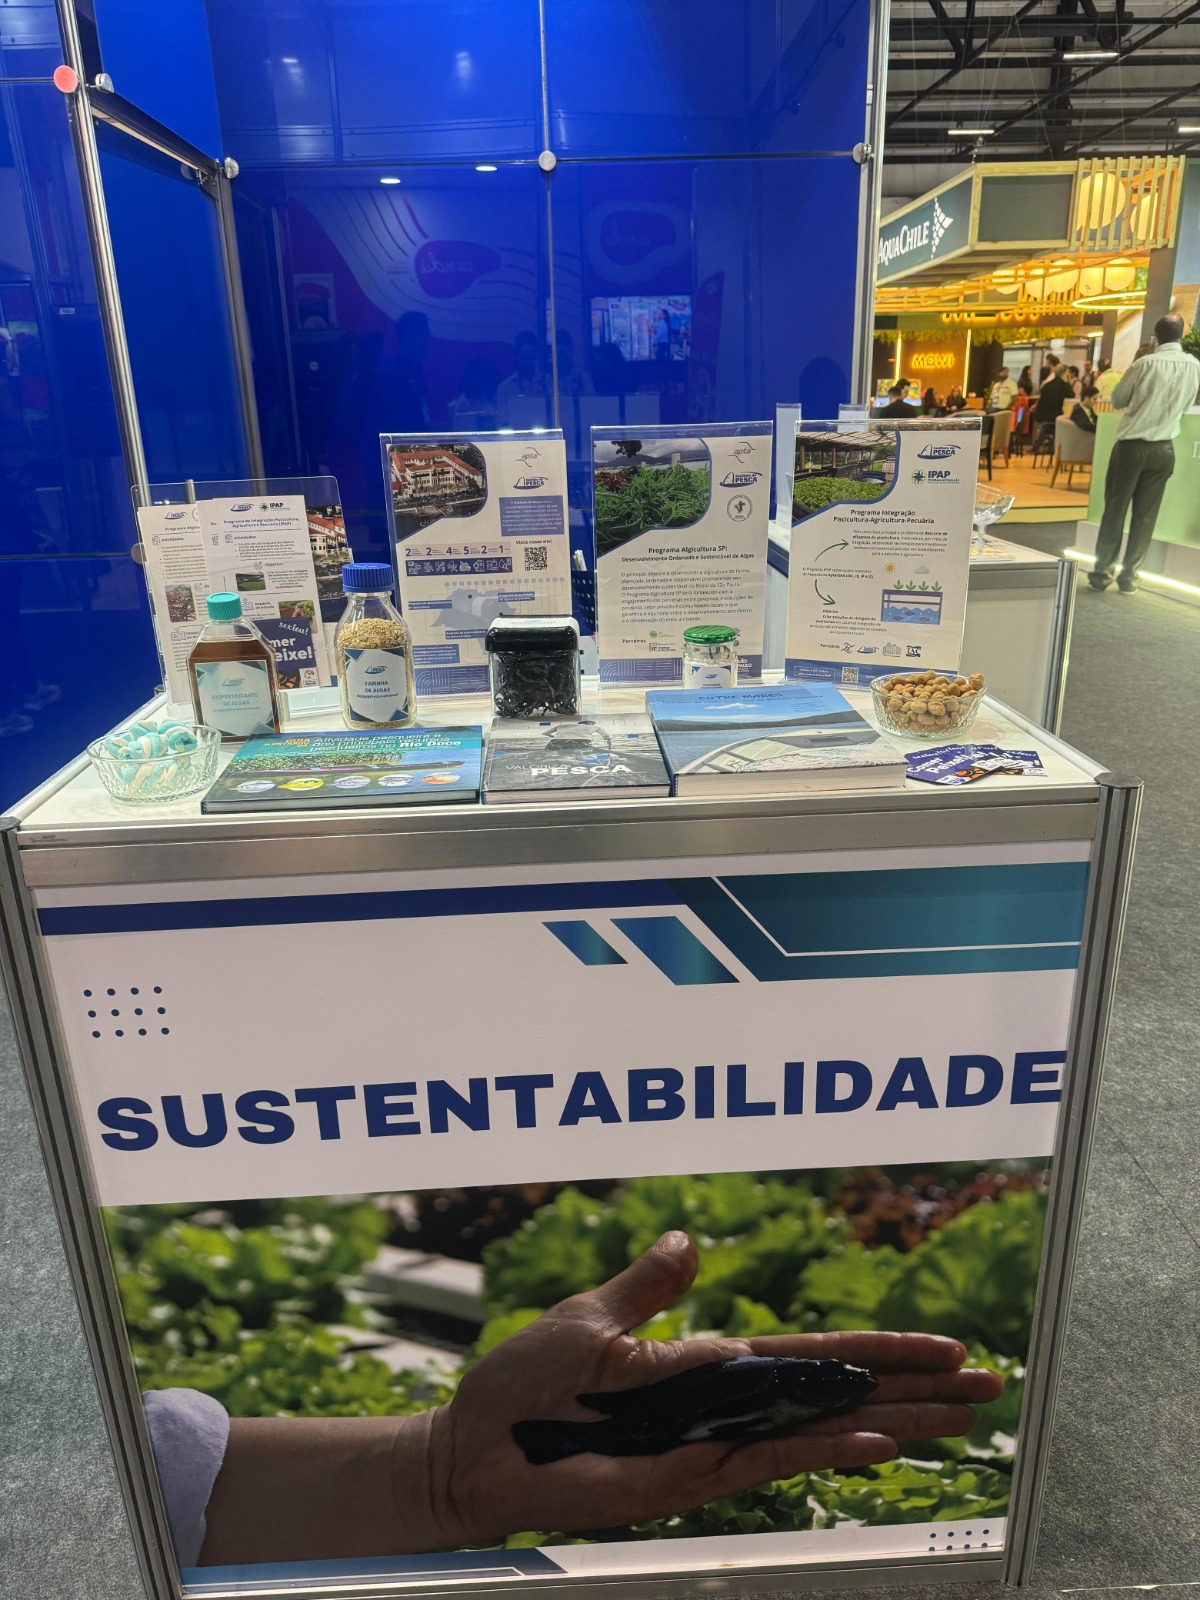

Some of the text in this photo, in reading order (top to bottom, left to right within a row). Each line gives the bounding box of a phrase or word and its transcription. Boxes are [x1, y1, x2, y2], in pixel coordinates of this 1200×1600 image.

[912, 353, 955, 369] MOWI
[834, 516, 934, 524] Piscicultura-Agricultura-Pecuária
[426, 548, 432, 556] 2
[446, 547, 452, 555] 4
[464, 546, 469, 555] 5
[481, 546, 487, 554] 2
[498, 545, 504, 553] 1
[681, 546, 717, 554] Algicultura
[279, 622, 308, 635] sextou!
[270, 638, 296, 648] mer
[275, 646, 312, 662] eixe!
[310, 744, 377, 753] pesqueiros
[335, 739, 395, 747] principais
[530, 764, 632, 776] PESCA
[97, 1050, 1068, 1151] SUSTENTABILIDADE
